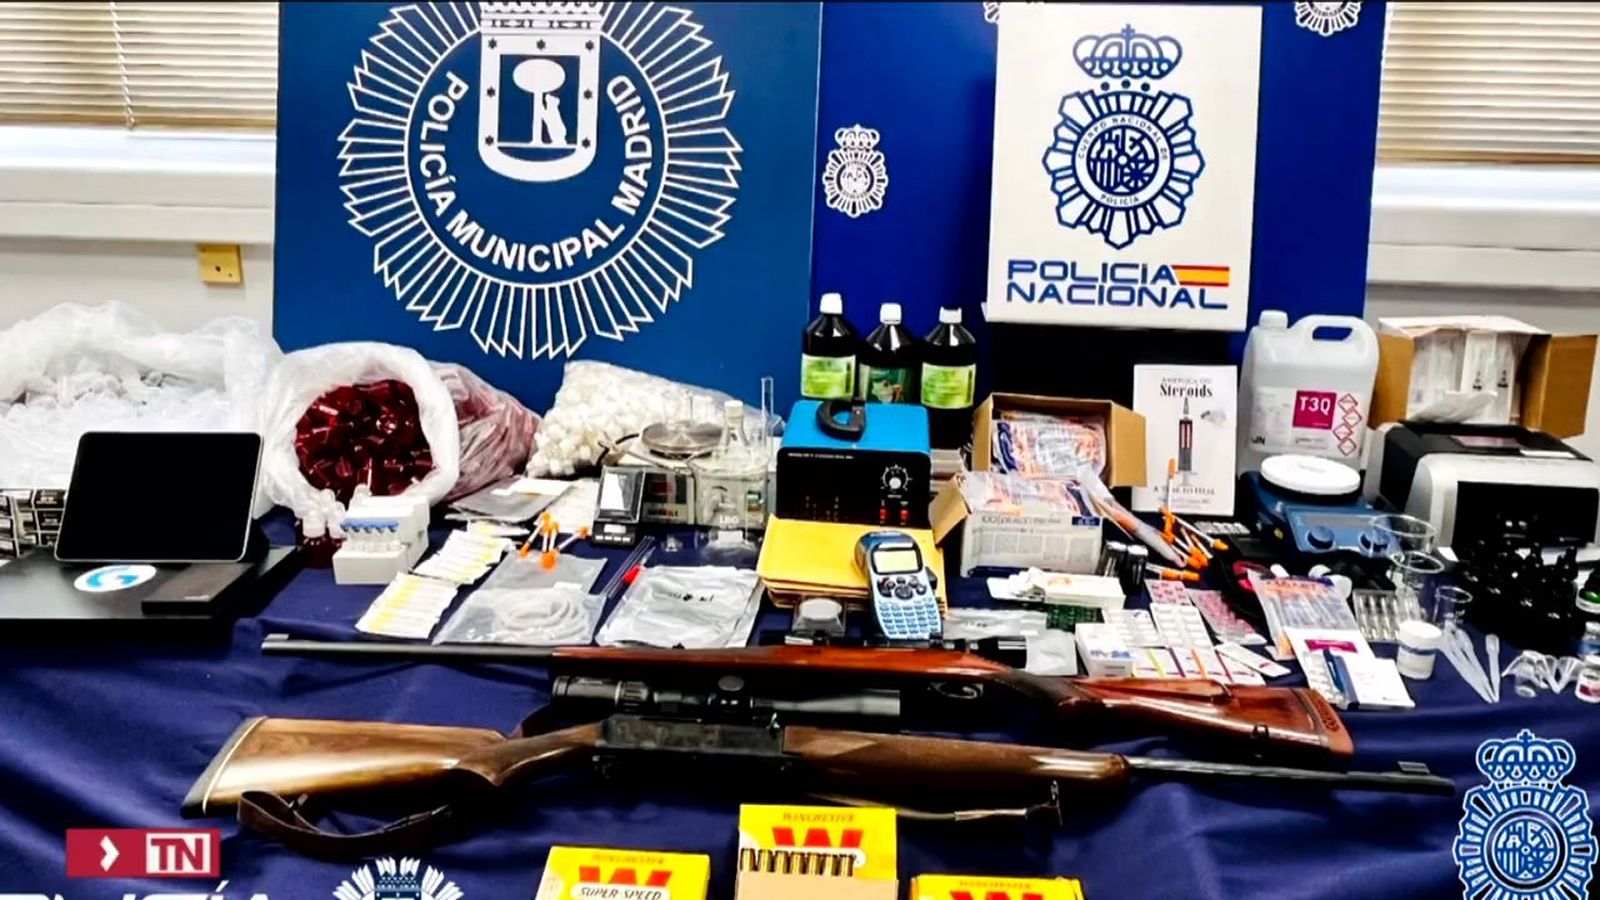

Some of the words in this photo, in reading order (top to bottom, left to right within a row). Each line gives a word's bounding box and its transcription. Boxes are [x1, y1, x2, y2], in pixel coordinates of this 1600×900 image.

[1111, 116, 1162, 143] NACIONAL
[419, 71, 470, 217] POLICÍA
[445, 209, 626, 274] MUNICIPAL
[606, 74, 653, 216] MADRID
[1006, 281, 1229, 310] NACIONAL
[1160, 383, 1213, 399] Steroids
[1299, 396, 1331, 417] T3Q
